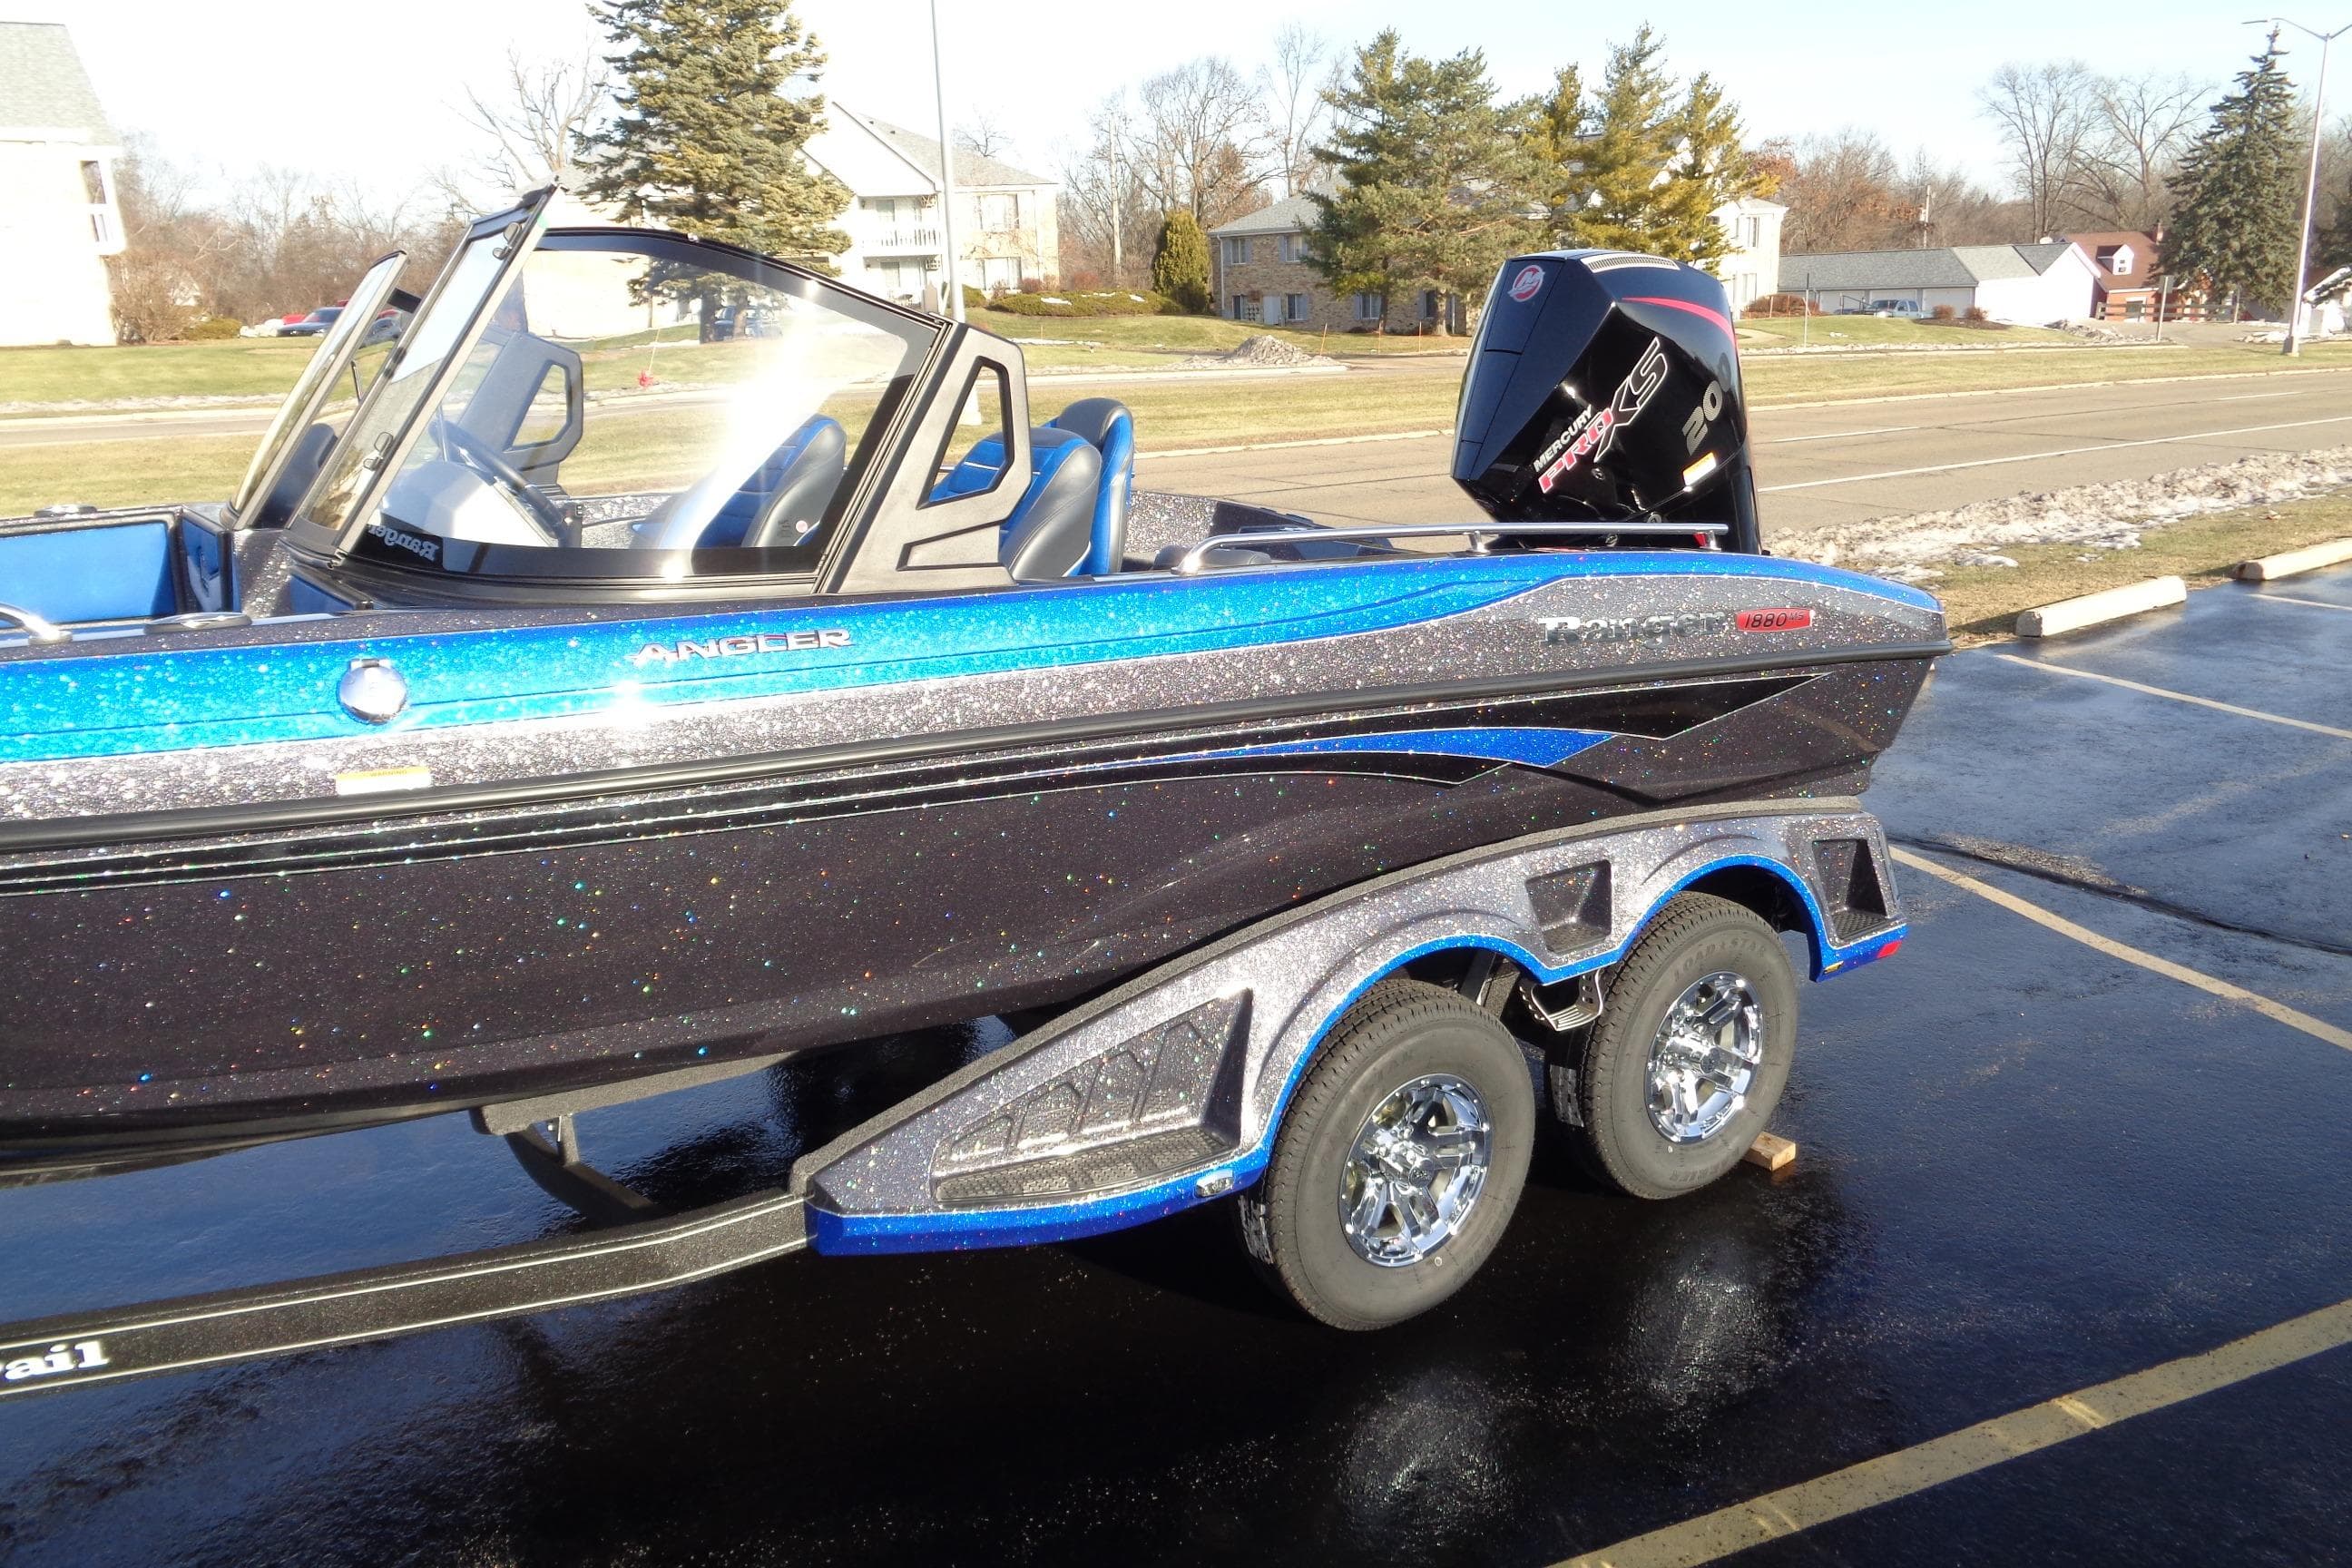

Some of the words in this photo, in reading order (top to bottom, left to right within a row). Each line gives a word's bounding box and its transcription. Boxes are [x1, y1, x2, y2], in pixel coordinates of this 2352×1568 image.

[1533, 404, 1592, 472] MERCURY
[626, 628, 855, 666] ANGLER
[1537, 611, 1725, 651] Ranger
[1745, 612, 1787, 628] 1880
[0, 1340, 109, 1380] ail
